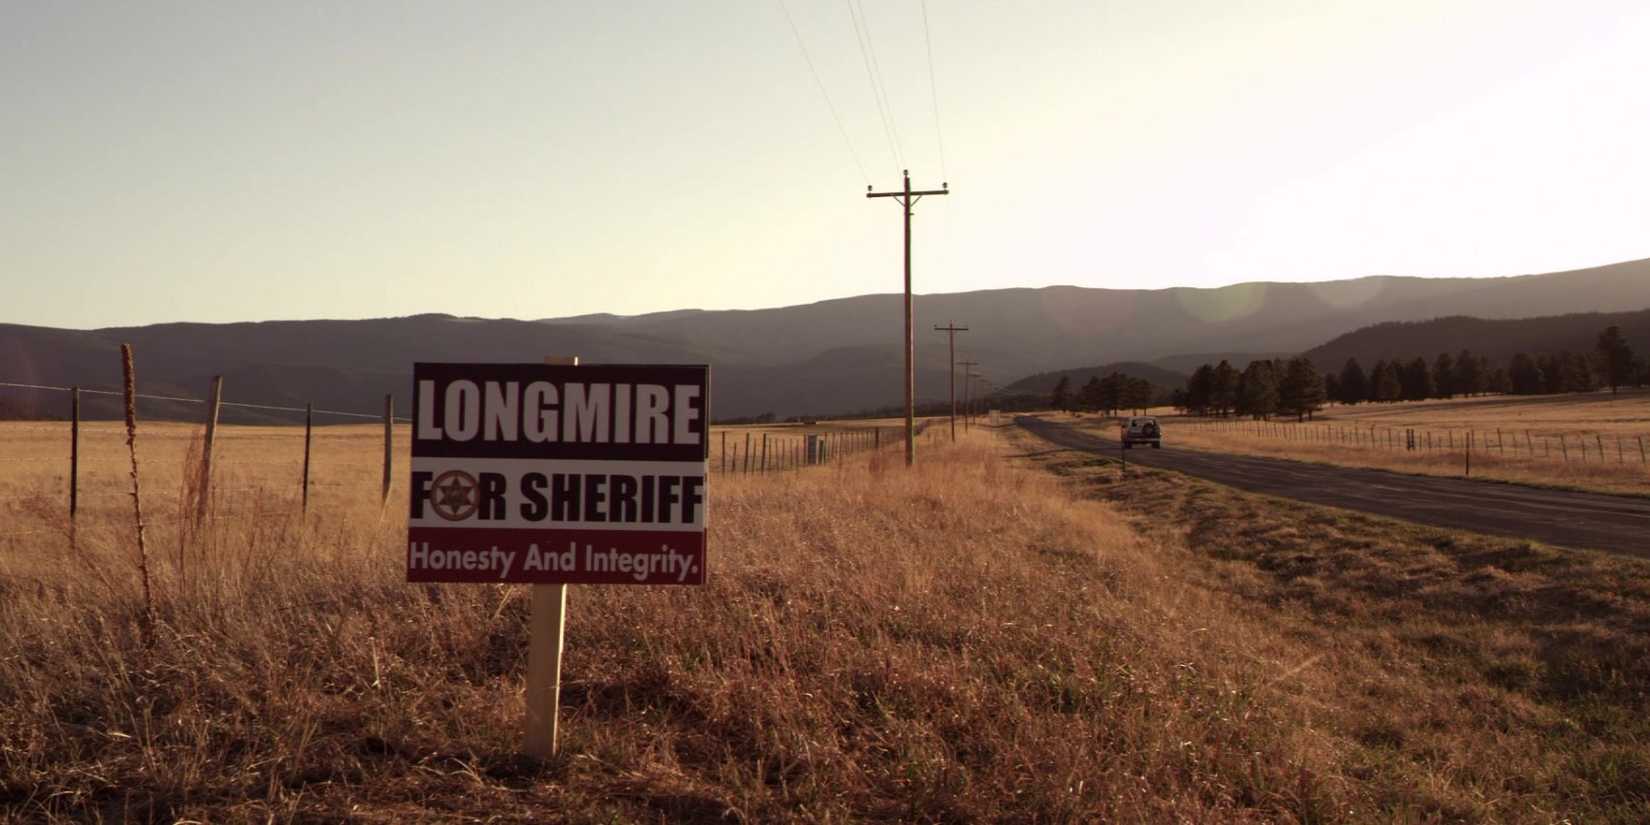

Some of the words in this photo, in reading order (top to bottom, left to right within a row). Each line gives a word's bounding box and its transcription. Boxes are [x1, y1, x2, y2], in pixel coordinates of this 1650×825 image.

[417, 379, 700, 444] LONGMIRE
[411, 470, 507, 522] FOR
[520, 472, 704, 523] SHERIFF
[410, 542, 516, 579] Honesty
[524, 542, 576, 572] And
[586, 545, 698, 581] Integrity.
